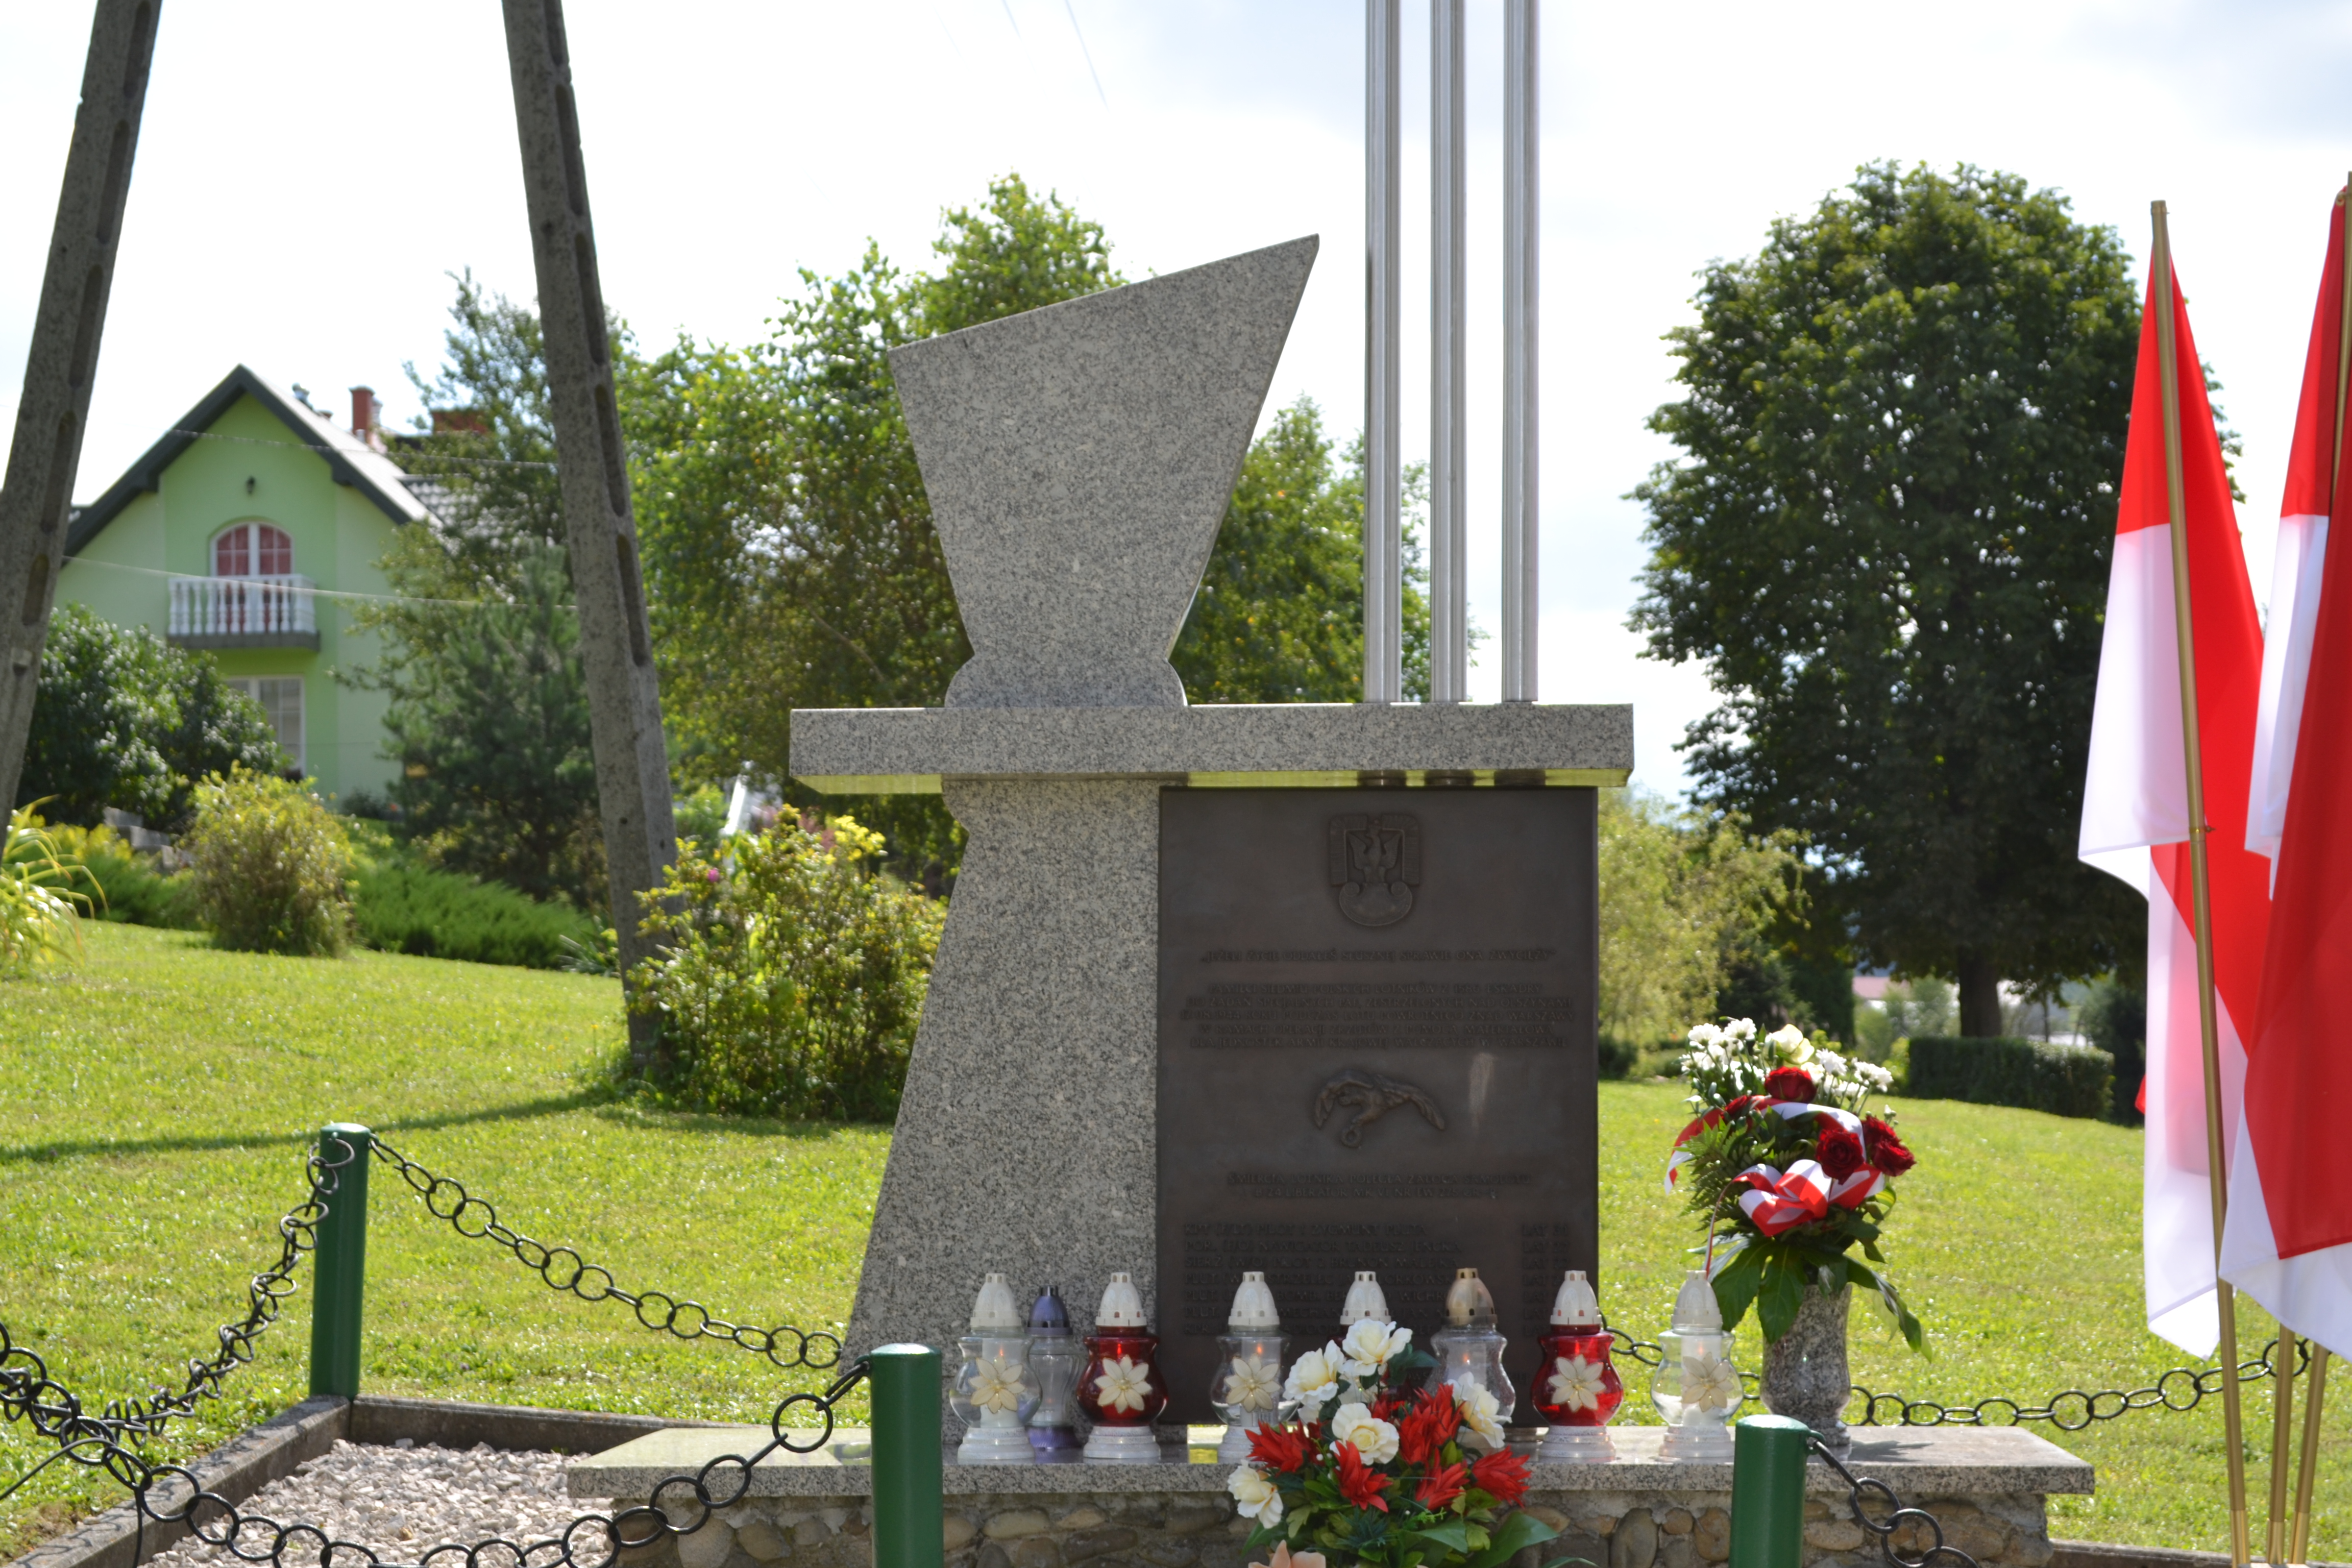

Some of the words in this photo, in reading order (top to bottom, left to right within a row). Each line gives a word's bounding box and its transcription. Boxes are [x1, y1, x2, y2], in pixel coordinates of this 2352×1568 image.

[1400, 950, 1452, 962] SPRAWIE
[1456, 950, 1483, 961] ONA
[1261, 984, 1307, 994] SIEDMIU
[1314, 984, 1369, 994] POLSKICH
[1440, 984, 1449, 993] Z
[1455, 984, 1480, 993] 1586
[1487, 983, 1542, 993] ESKADRY
[1186, 997, 1206, 1007] DO
[1257, 997, 1334, 1009] SPECJALNYCH
[1366, 997, 1463, 1007] ZESTRZELONYCH
[1469, 997, 1495, 1007] NAD
[1500, 997, 1572, 1008] OLSZYNAMI
[1246, 1010, 1277, 1020] ROKU
[1283, 1010, 1338, 1020] PODCZAS
[1344, 1010, 1375, 1020] LOTU
[1381, 1010, 1464, 1020] POWROTNEGO
[1469, 1010, 1503, 1020] ZNAD
[1507, 1010, 1574, 1021] WARSZAWY
[1199, 1024, 1211, 1034] W
[1215, 1024, 1268, 1034] RAMACH
[1273, 1024, 1325, 1036] OPERACJI
[1393, 1024, 1401, 1034] Z
[1190, 1037, 1215, 1047] DLA
[1219, 1037, 1282, 1048] JEDNOSTEK
[1290, 1037, 1324, 1047] ARMII
[1329, 1037, 1388, 1049] KRAJOWEJ
[1480, 1037, 1490, 1047] W
[1498, 1037, 1567, 1047] WARSZAWIE
[1291, 1174, 1344, 1184] LOTNIKA
[1463, 1174, 1530, 1185] SAMOLOTU
[1267, 1188, 1282, 1197] 24
[1285, 1188, 1348, 1198] LIBERATOR
[1354, 1188, 1373, 1197] MK
[1378, 1188, 1389, 1197] VI
[1394, 1188, 1411, 1197] NR
[1311, 1224, 1378, 1235] ZYGMUNT
[1259, 1241, 1341, 1252] NAWIGATOR
[1345, 1241, 1404, 1252] TADEUSZ
